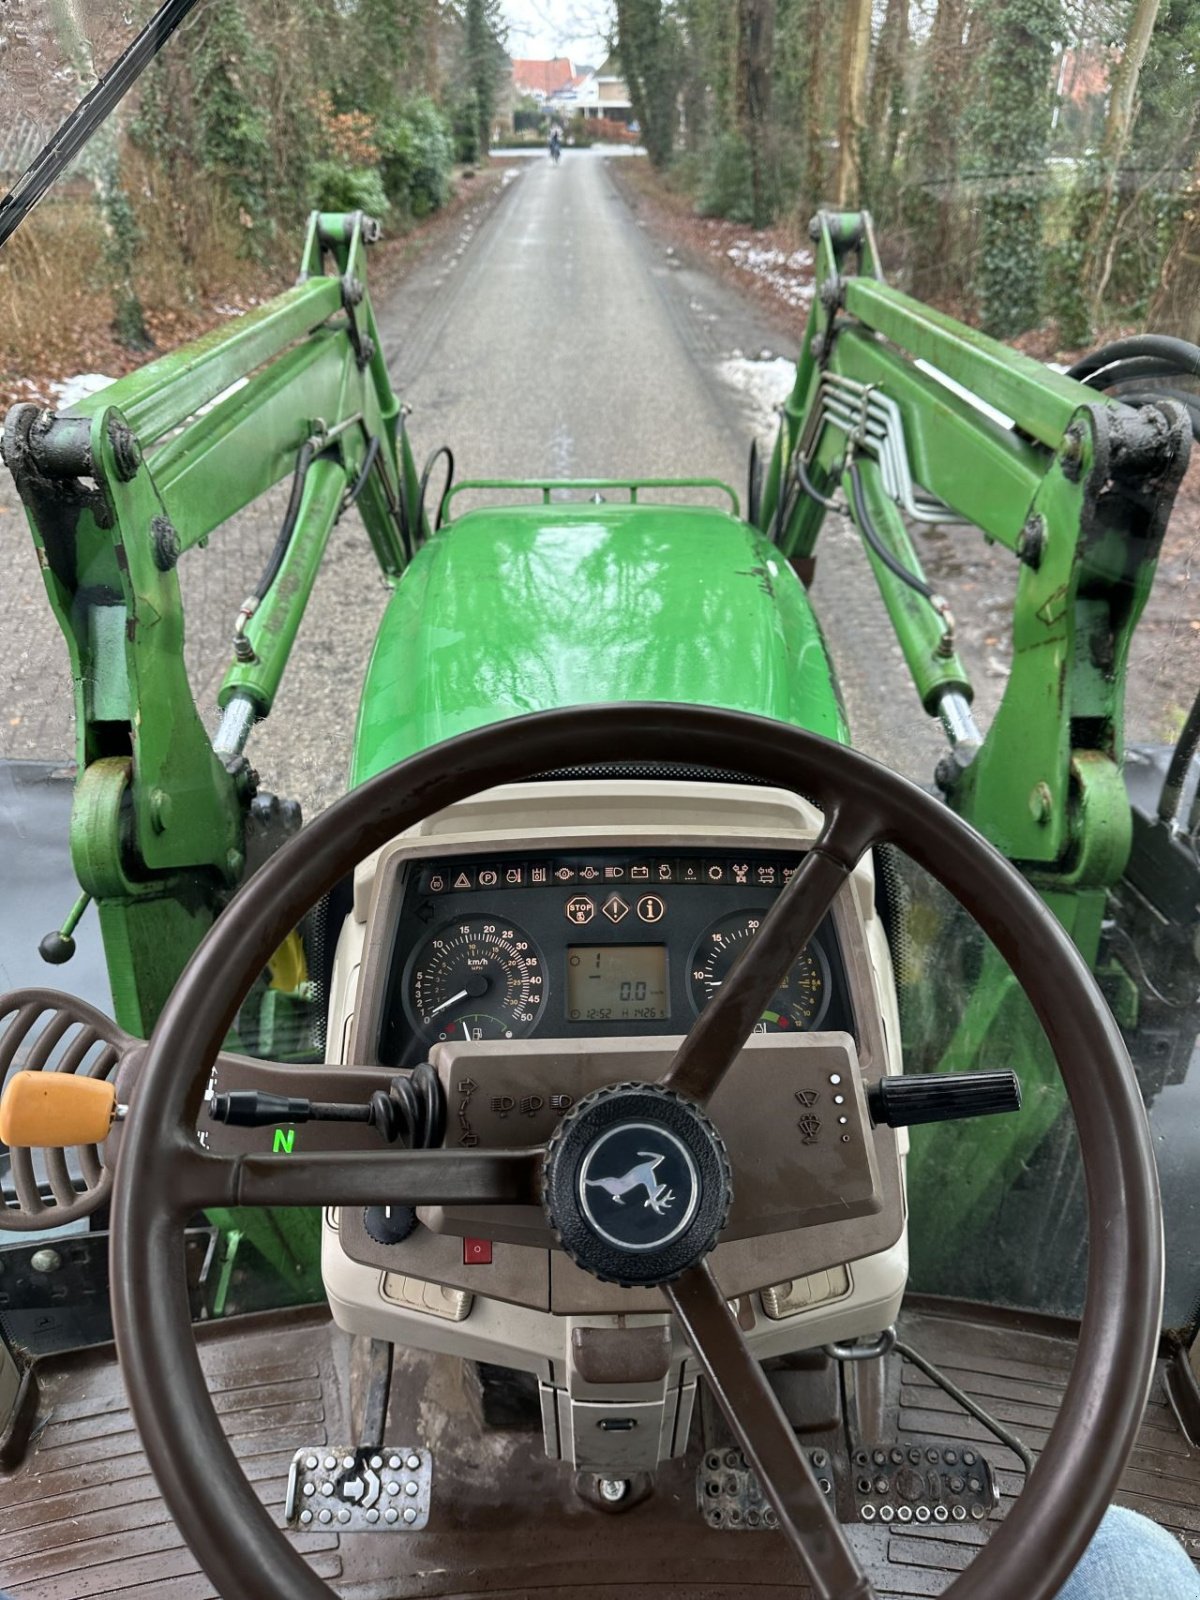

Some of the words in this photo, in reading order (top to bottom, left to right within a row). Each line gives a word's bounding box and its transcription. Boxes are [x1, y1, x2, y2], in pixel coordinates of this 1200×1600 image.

[748, 920, 760, 928] 20
[459, 926, 470, 934] 15
[483, 925, 496, 933] 20
[502, 930, 514, 939] 25
[712, 933, 722, 942] 15
[432, 940, 443, 949] 10
[516, 942, 528, 950] 30
[526, 958, 537, 966] 35
[416, 972, 423, 980] 5
[693, 971, 704, 980] 10
[530, 976, 542, 984] 40
[415, 981, 422, 989] 4
[416, 999, 423, 1007] 2
[528, 995, 540, 1003] 45
[420, 1008, 425, 1016] 1
[424, 1016, 430, 1024] 0
[520, 1013, 533, 1022] 50
[273, 1129, 295, 1153] N
